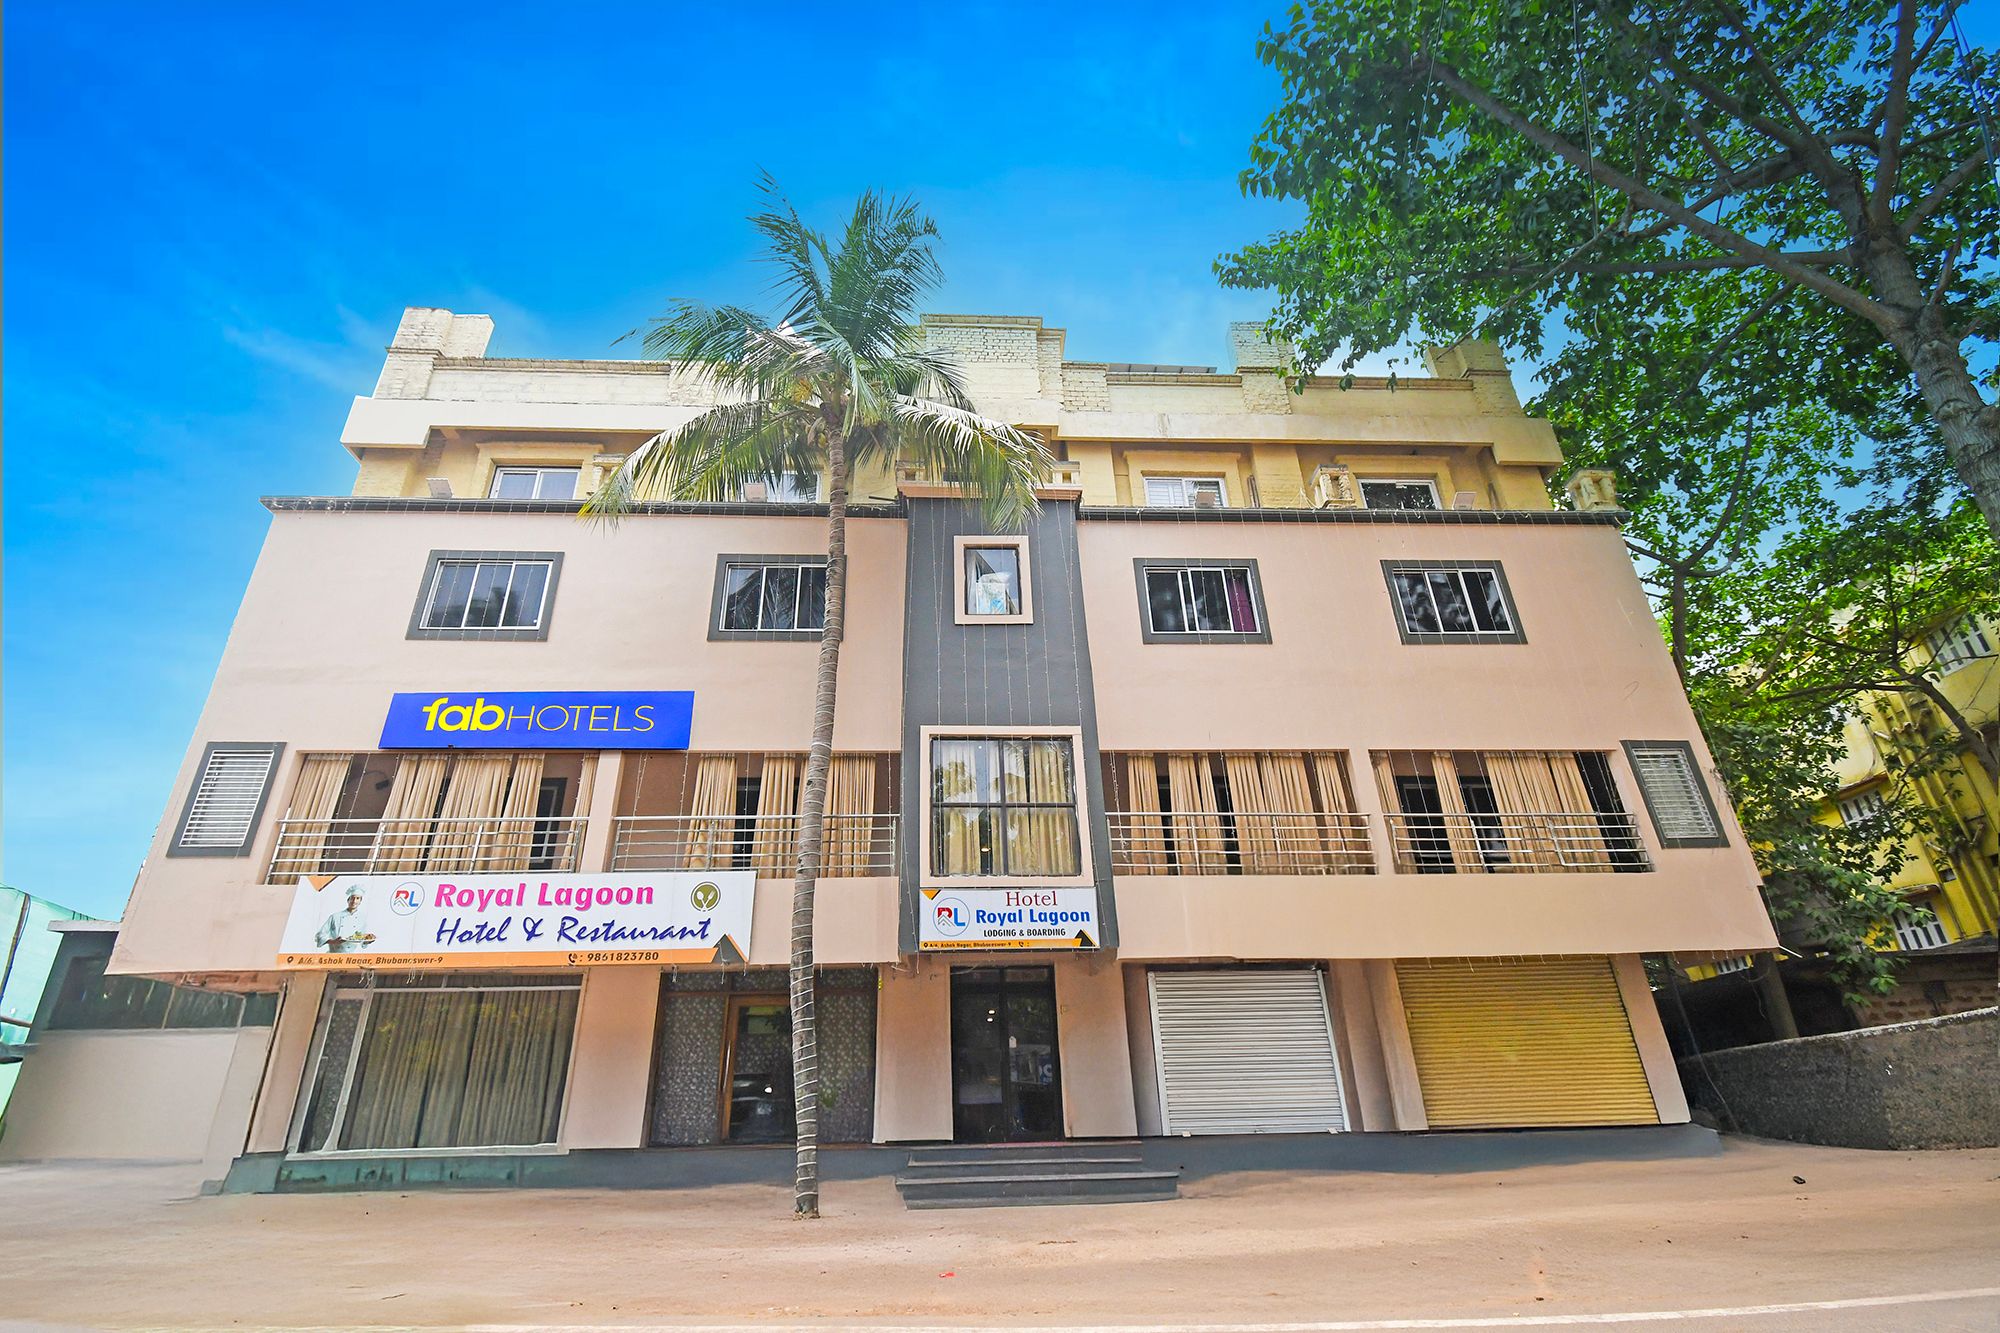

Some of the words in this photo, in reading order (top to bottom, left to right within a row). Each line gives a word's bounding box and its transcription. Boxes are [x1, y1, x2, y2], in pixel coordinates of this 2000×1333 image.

[434, 883, 527, 913] Royal
[537, 882, 654, 912] Lagoon
[1005, 890, 1058, 907] Hotel
[975, 909, 1023, 927] Royal
[1029, 908, 1091, 926] Lagoon
[435, 916, 513, 946] Hotel
[522, 916, 545, 942] &
[556, 914, 712, 944] Restaurant
[983, 929, 1017, 938] LODGING
[1018, 929, 1025, 938] &
[1026, 928, 1066, 938] BOARDING
[587, 951, 659, 962] 9861823780
